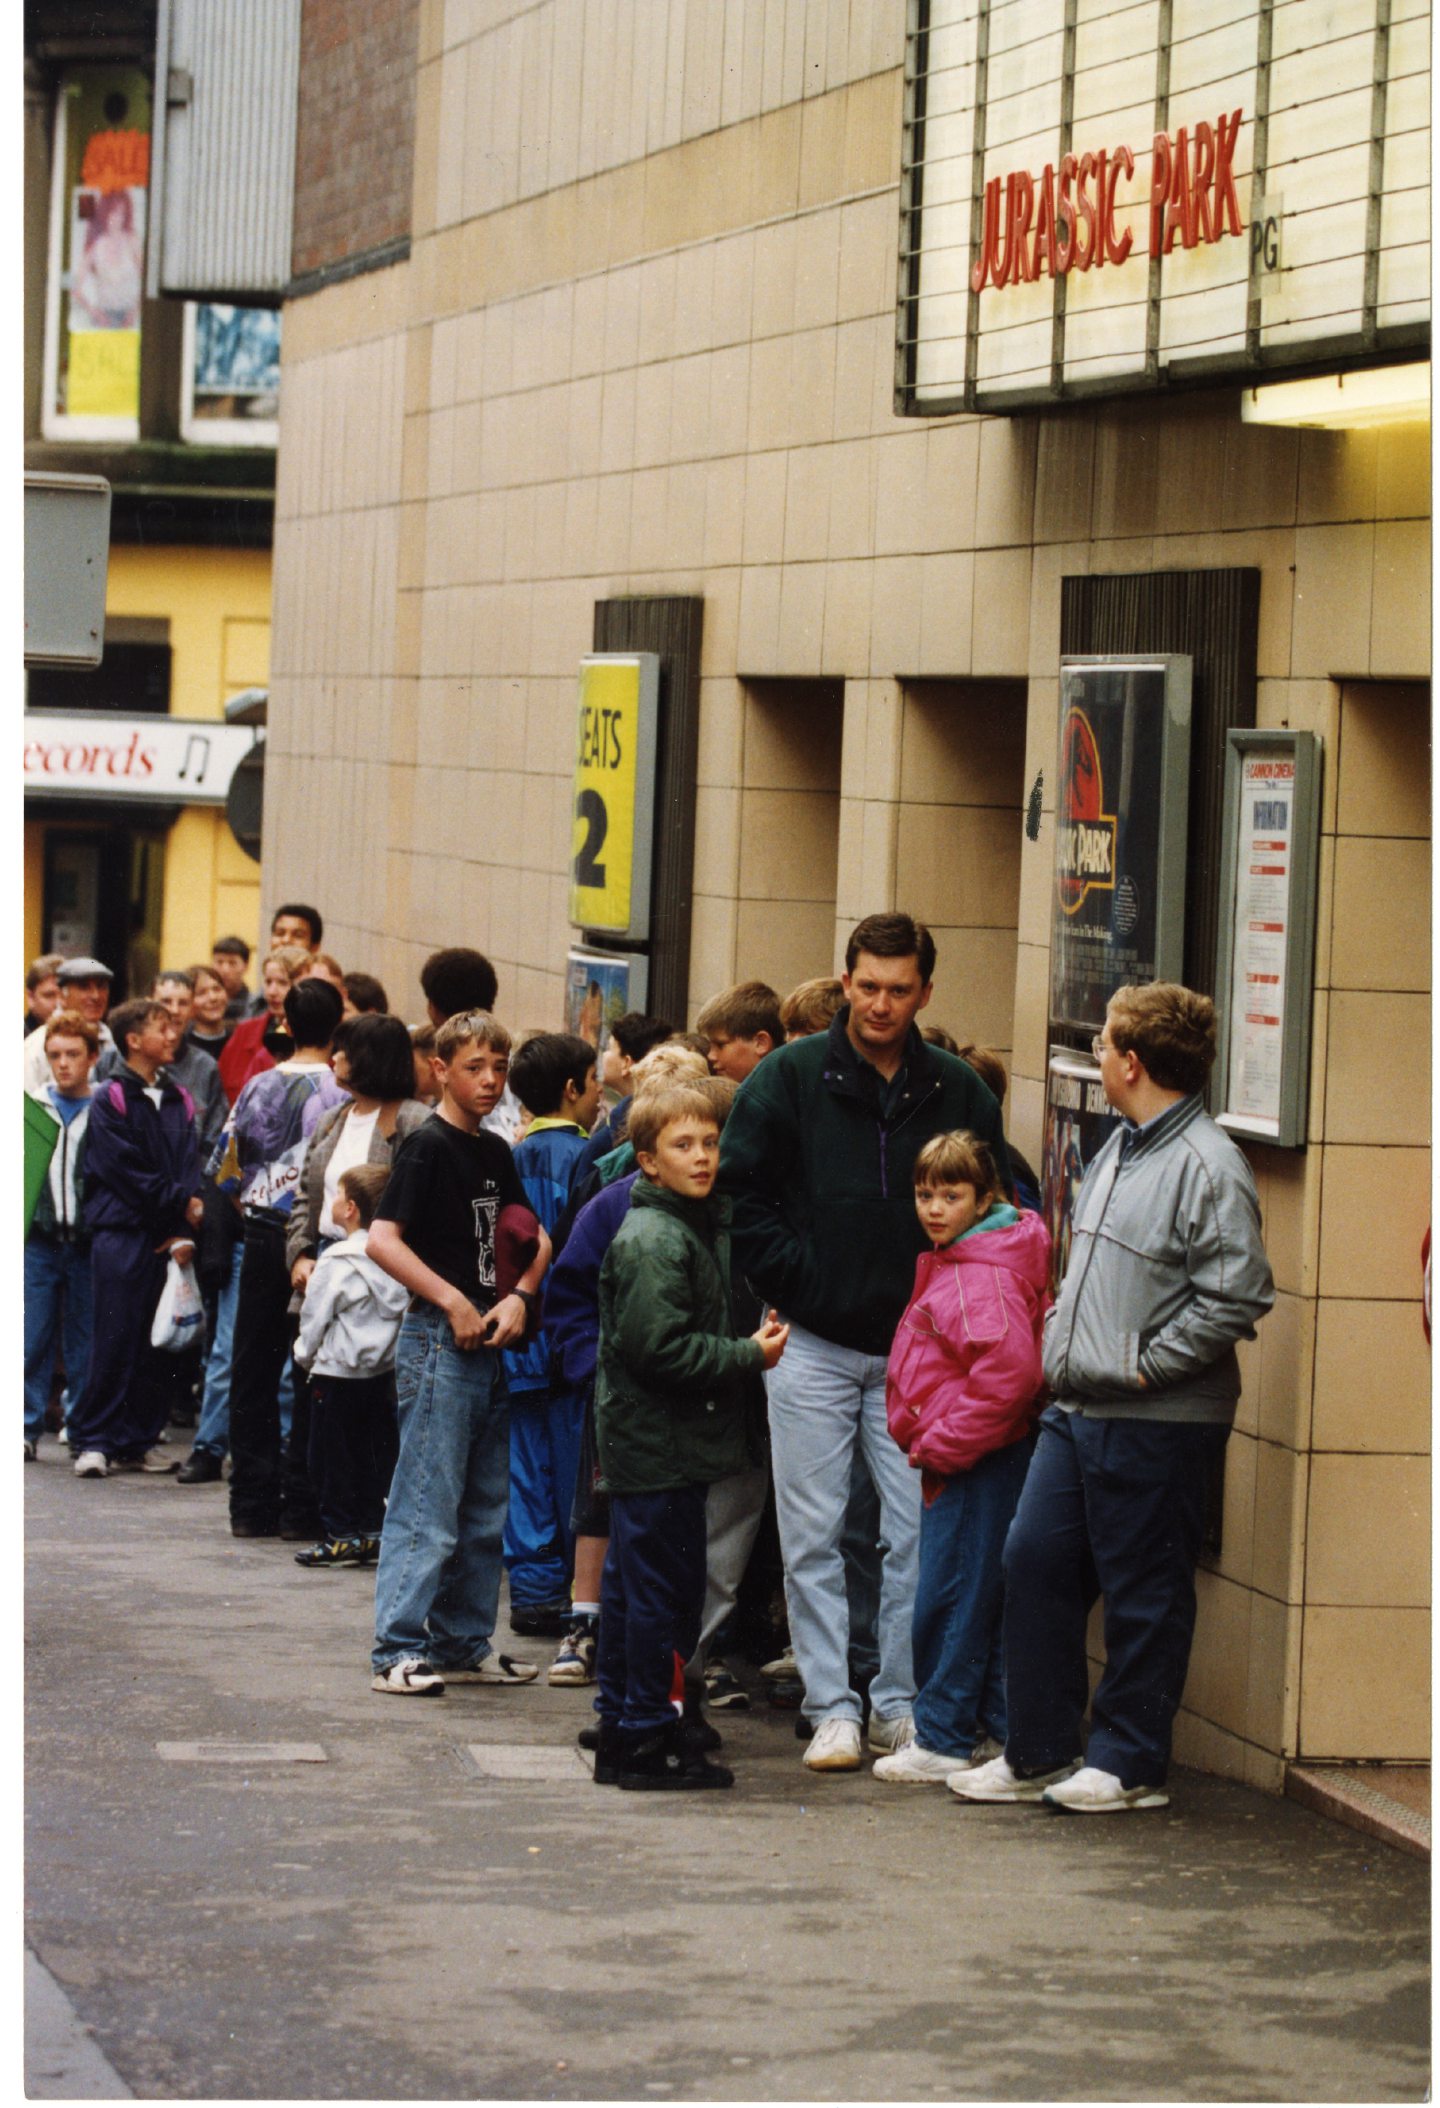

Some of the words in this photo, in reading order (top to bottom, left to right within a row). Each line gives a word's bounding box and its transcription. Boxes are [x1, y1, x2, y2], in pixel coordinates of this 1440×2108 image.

[972, 144, 1134, 293] JURASSIC
[1149, 107, 1243, 259] PARK
[1252, 215, 1279, 271] PG
[573, 788, 608, 889] 2
[1077, 823, 1112, 876] PARK
